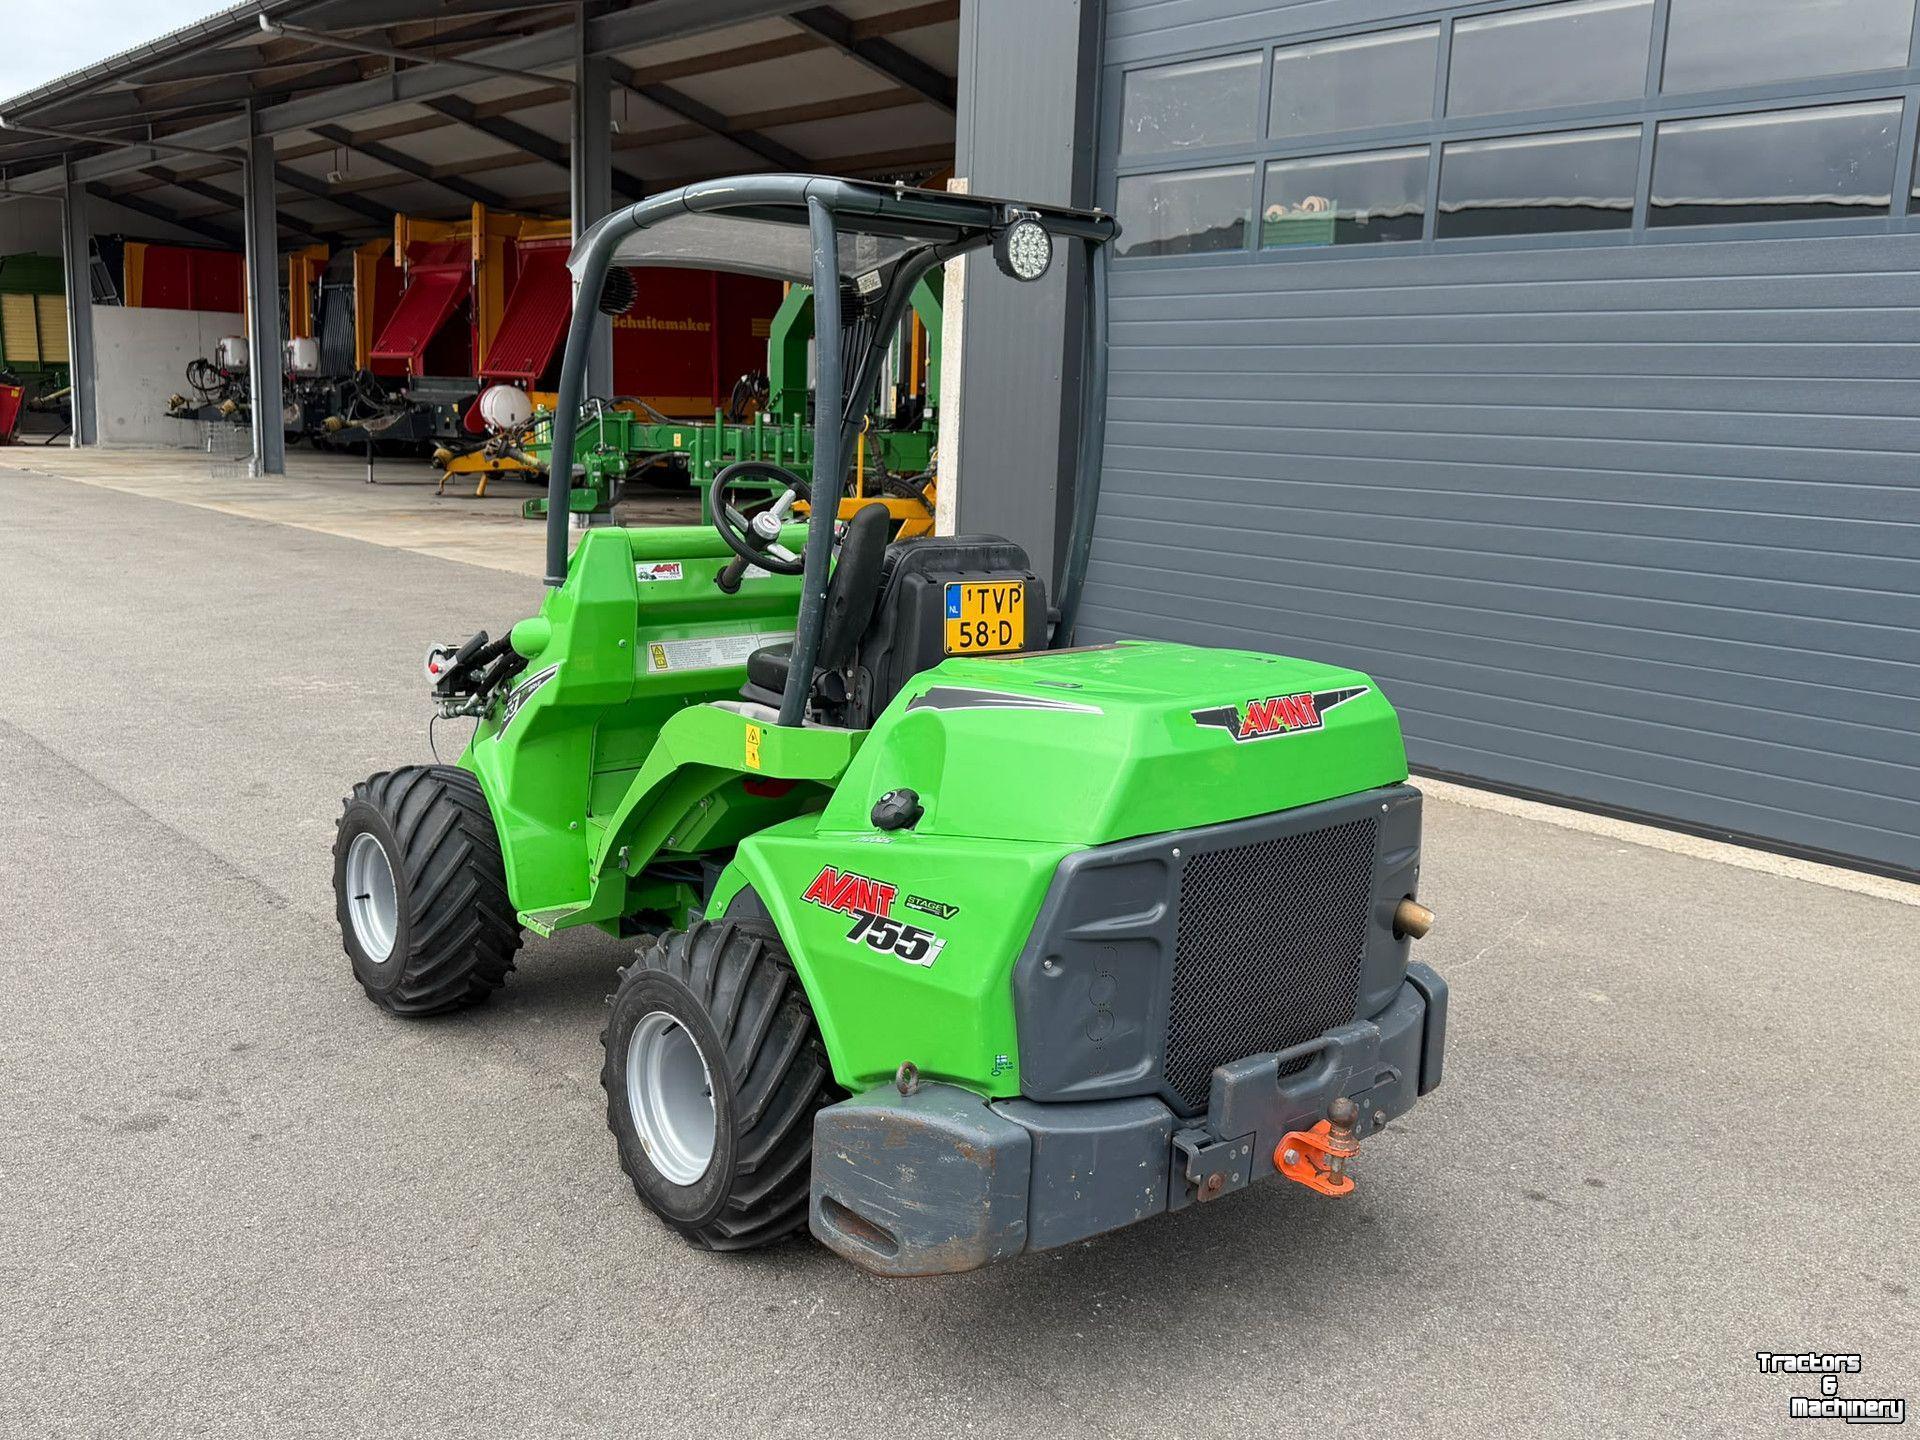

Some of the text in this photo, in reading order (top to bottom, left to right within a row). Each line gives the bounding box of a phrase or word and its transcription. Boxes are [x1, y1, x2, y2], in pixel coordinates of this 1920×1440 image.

[949, 605, 959, 614] NL
[1237, 691, 1320, 738] AVANT
[801, 864, 897, 917] AVANT
[907, 896, 943, 911] STAGE
